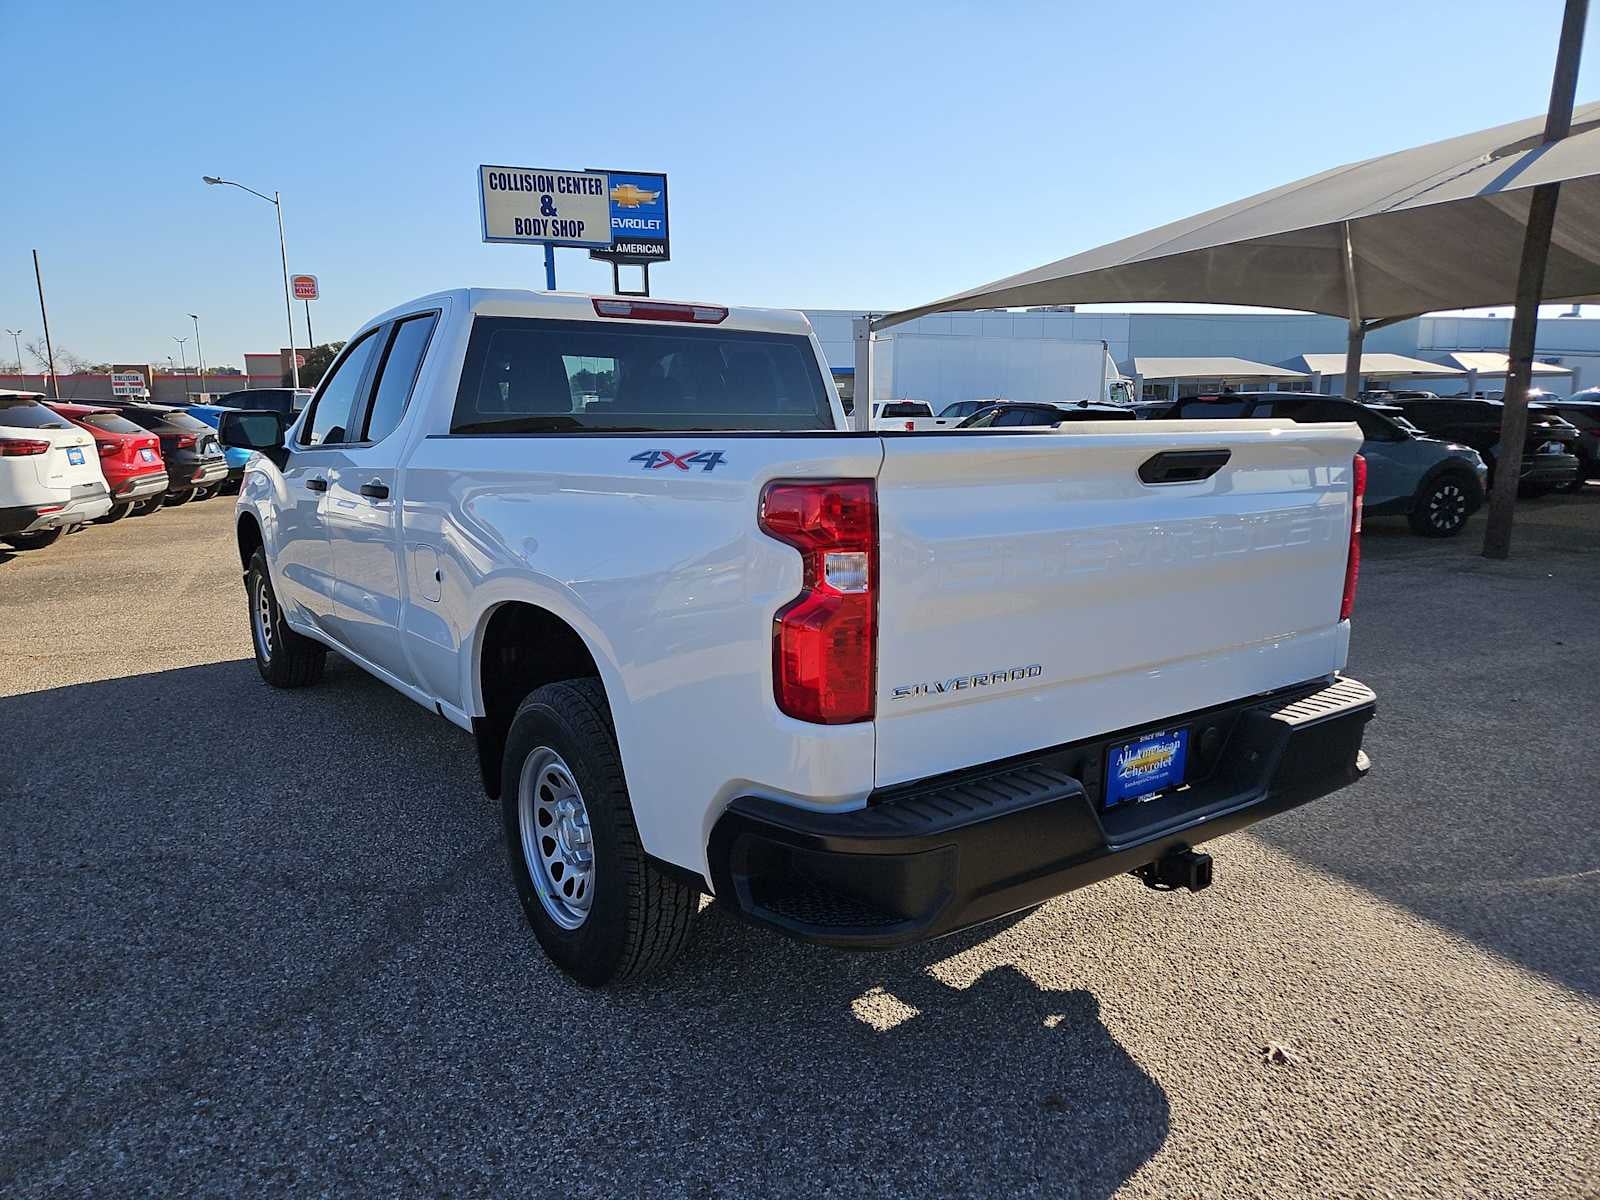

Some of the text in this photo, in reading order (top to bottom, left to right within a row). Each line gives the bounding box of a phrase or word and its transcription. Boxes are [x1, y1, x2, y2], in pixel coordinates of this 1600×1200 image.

[489, 172, 603, 195] COLLISION CENTER
[540, 194, 558, 217] &
[514, 217, 585, 238] BODY SHOP
[616, 243, 664, 254] AMERICAN
[295, 287, 317, 295] KING
[891, 664, 1042, 700] SILVERADO
[1116, 740, 1180, 766] All American
[1124, 757, 1172, 778] Chevrolet
